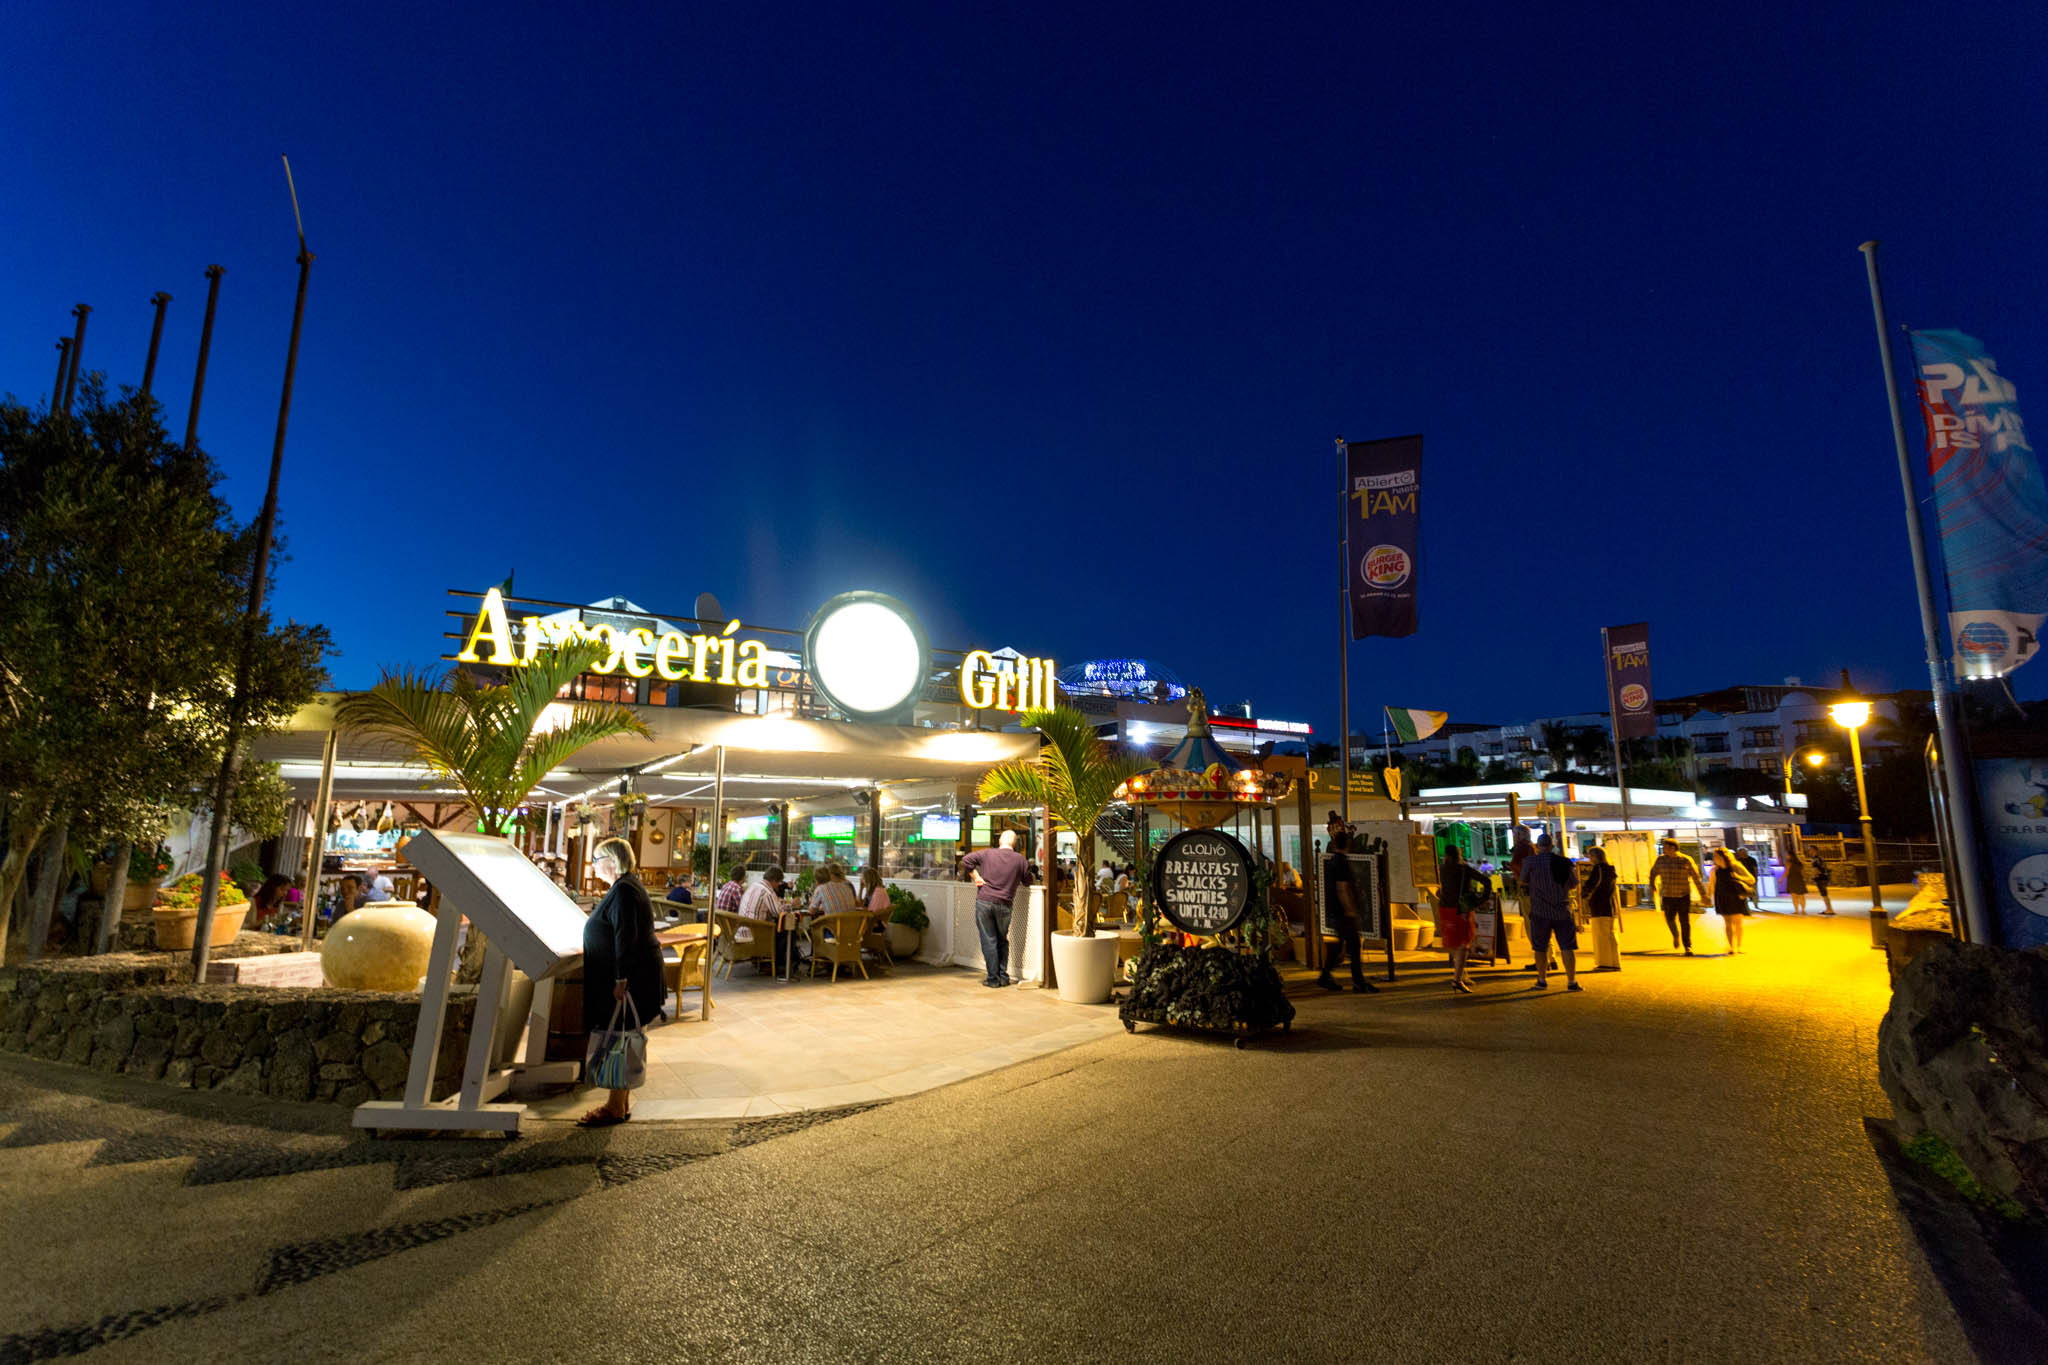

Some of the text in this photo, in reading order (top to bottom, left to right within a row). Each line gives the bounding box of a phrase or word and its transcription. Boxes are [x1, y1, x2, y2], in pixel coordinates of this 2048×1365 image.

[1368, 553, 1403, 567] BURGER
[1368, 561, 1404, 580] KING
[458, 587, 769, 687] Arrocería
[961, 650, 1055, 714] Grill
[1165, 860, 1239, 876] BREAKFAST
